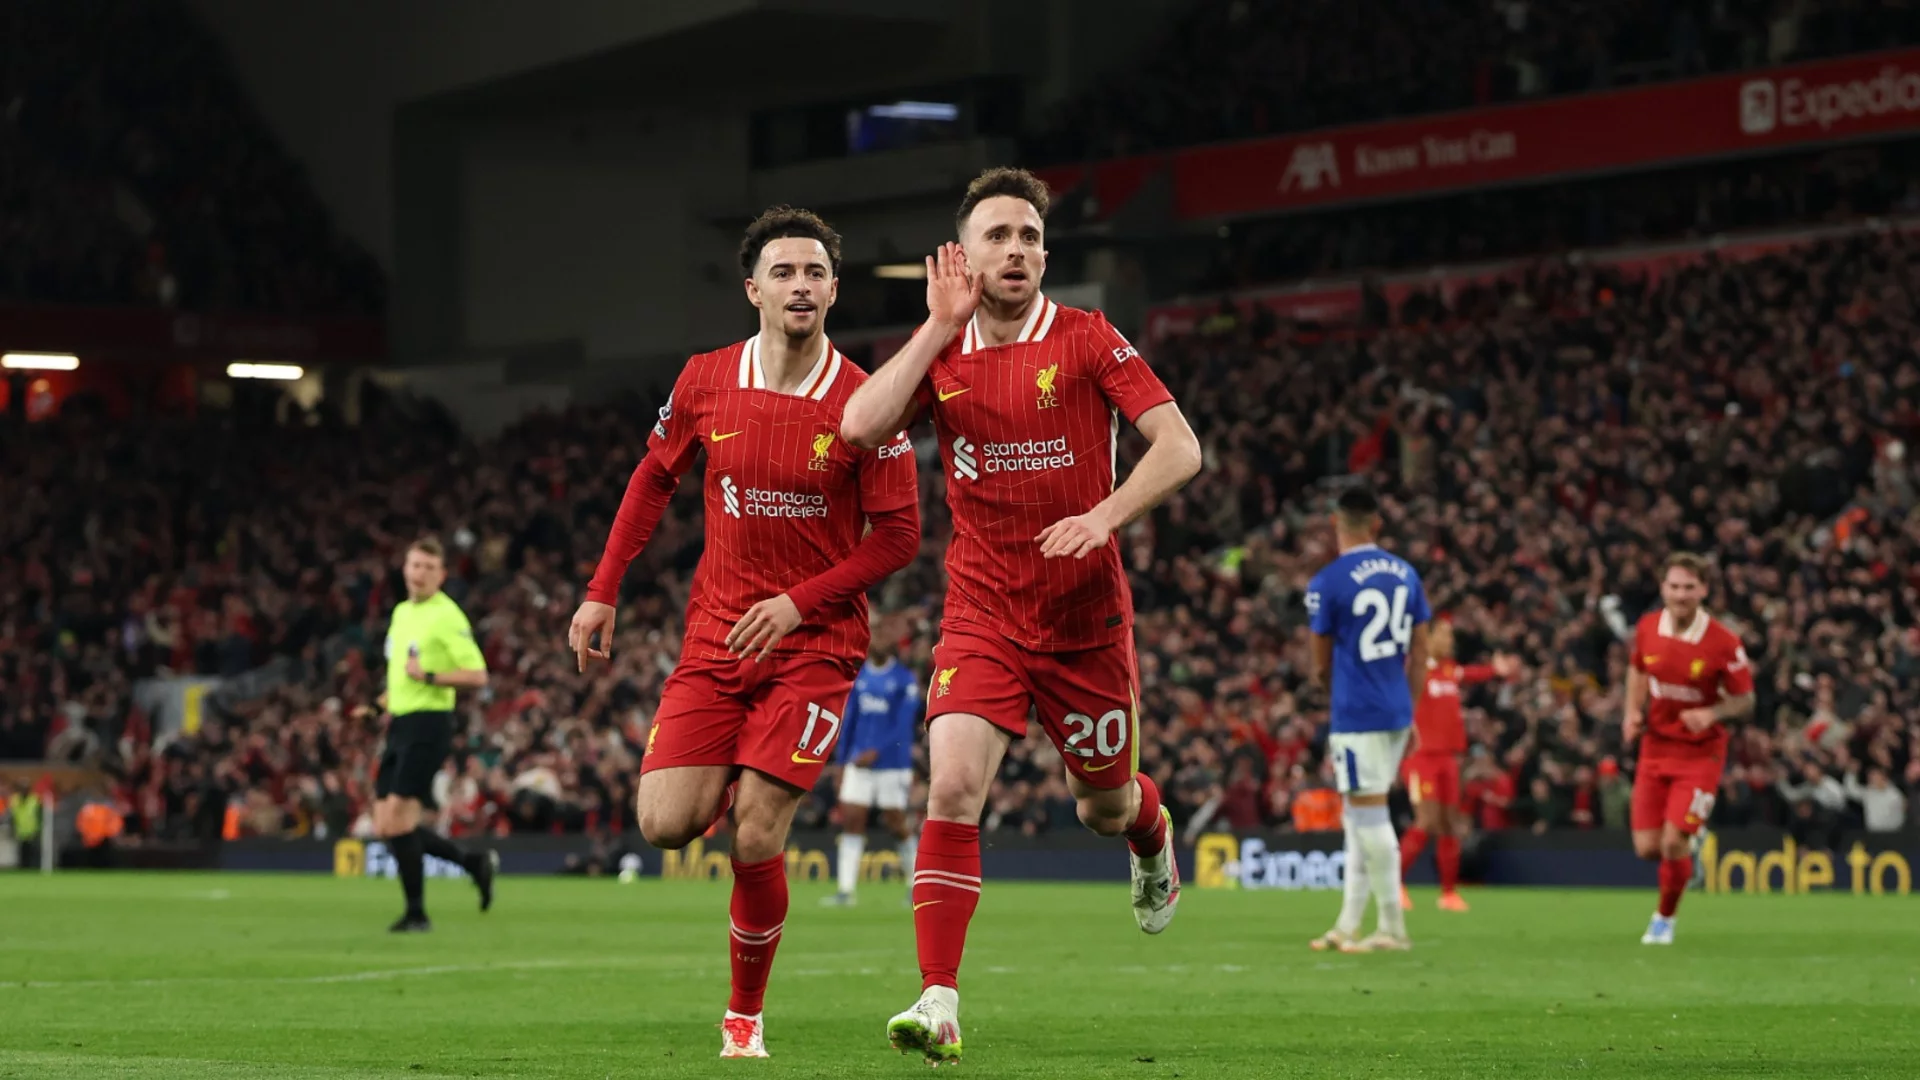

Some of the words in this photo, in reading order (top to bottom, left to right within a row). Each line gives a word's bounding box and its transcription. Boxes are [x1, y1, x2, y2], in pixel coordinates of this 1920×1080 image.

[983, 435, 1067, 457] standard
[985, 451, 1075, 474] chartered
[745, 486, 823, 505] standard
[745, 502, 828, 518] chartered
[1352, 585, 1413, 662] 24
[797, 701, 840, 757] 17
[1063, 708, 1127, 759] 20
[1846, 840, 1912, 895] to
